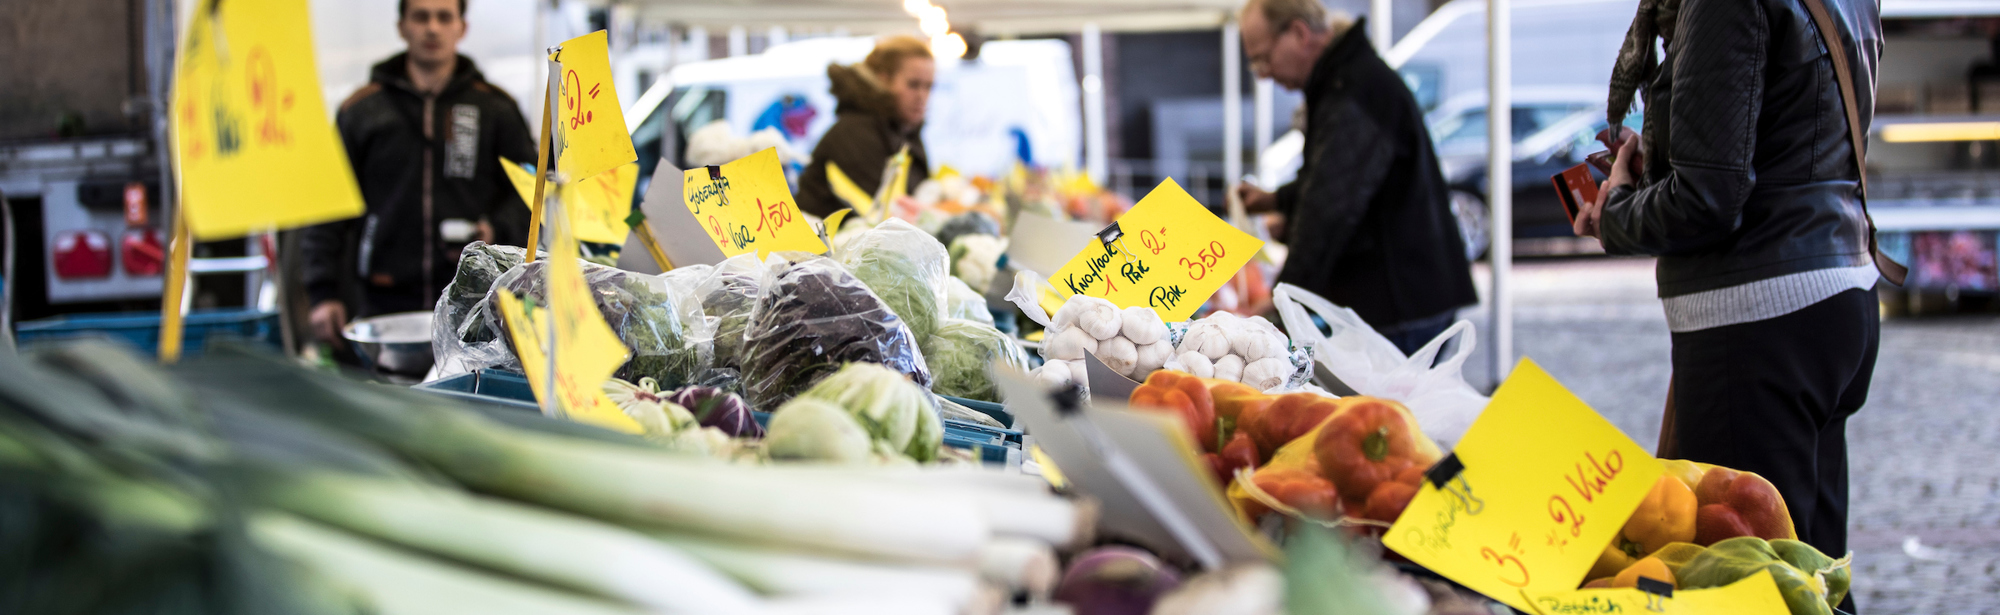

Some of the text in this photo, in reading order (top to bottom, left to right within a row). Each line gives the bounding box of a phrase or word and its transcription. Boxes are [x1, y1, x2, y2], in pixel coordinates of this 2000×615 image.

[708, 214, 729, 248] 2
[1104, 273, 1118, 296] 1
[1548, 494, 1585, 537] 2
